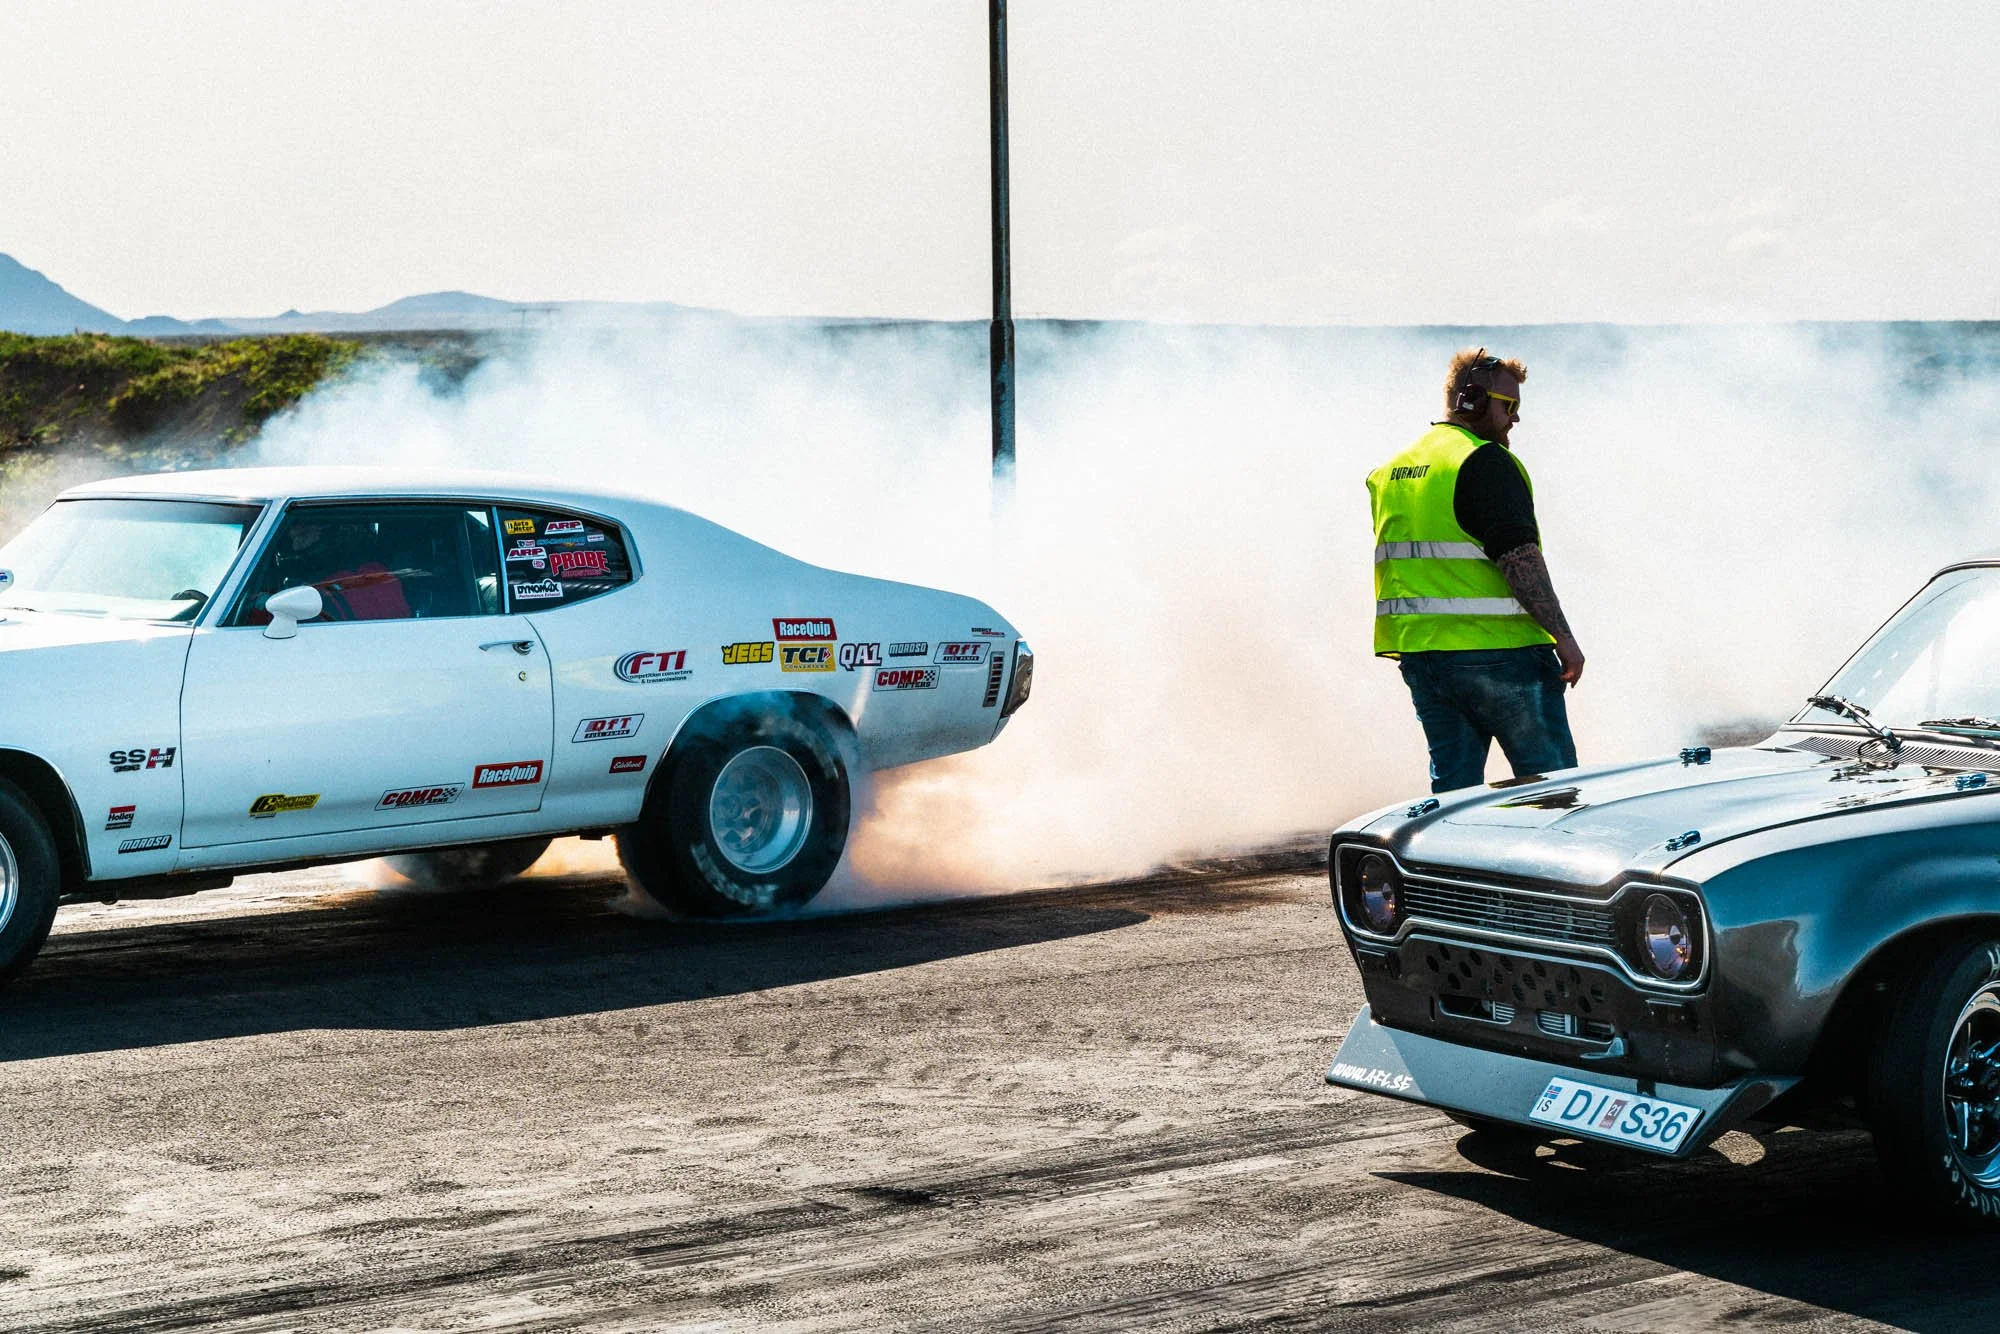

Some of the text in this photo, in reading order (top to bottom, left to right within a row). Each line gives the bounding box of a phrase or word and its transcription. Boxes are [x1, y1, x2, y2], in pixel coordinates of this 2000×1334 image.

[1390, 465, 1430, 480] BURNOUT
[548, 521, 581, 530] ARP
[509, 548, 543, 557] ARP
[549, 551, 611, 577] PROBE
[517, 581, 560, 594] DYNOMAX
[779, 621, 831, 637] RaceQuip
[721, 641, 774, 664] JEGS
[782, 647, 829, 664] TCI
[839, 642, 882, 671] QA1
[629, 650, 687, 674] FTI
[877, 670, 925, 687] COMP
[109, 748, 147, 765] SS
[478, 765, 538, 784] RaceQuip
[382, 788, 444, 805] COMP
[108, 812, 135, 822] Holley
[1536, 1098, 1553, 1112] IS
[1607, 1104, 1622, 1117] 21
[1560, 1089, 1688, 1143] DI S36
